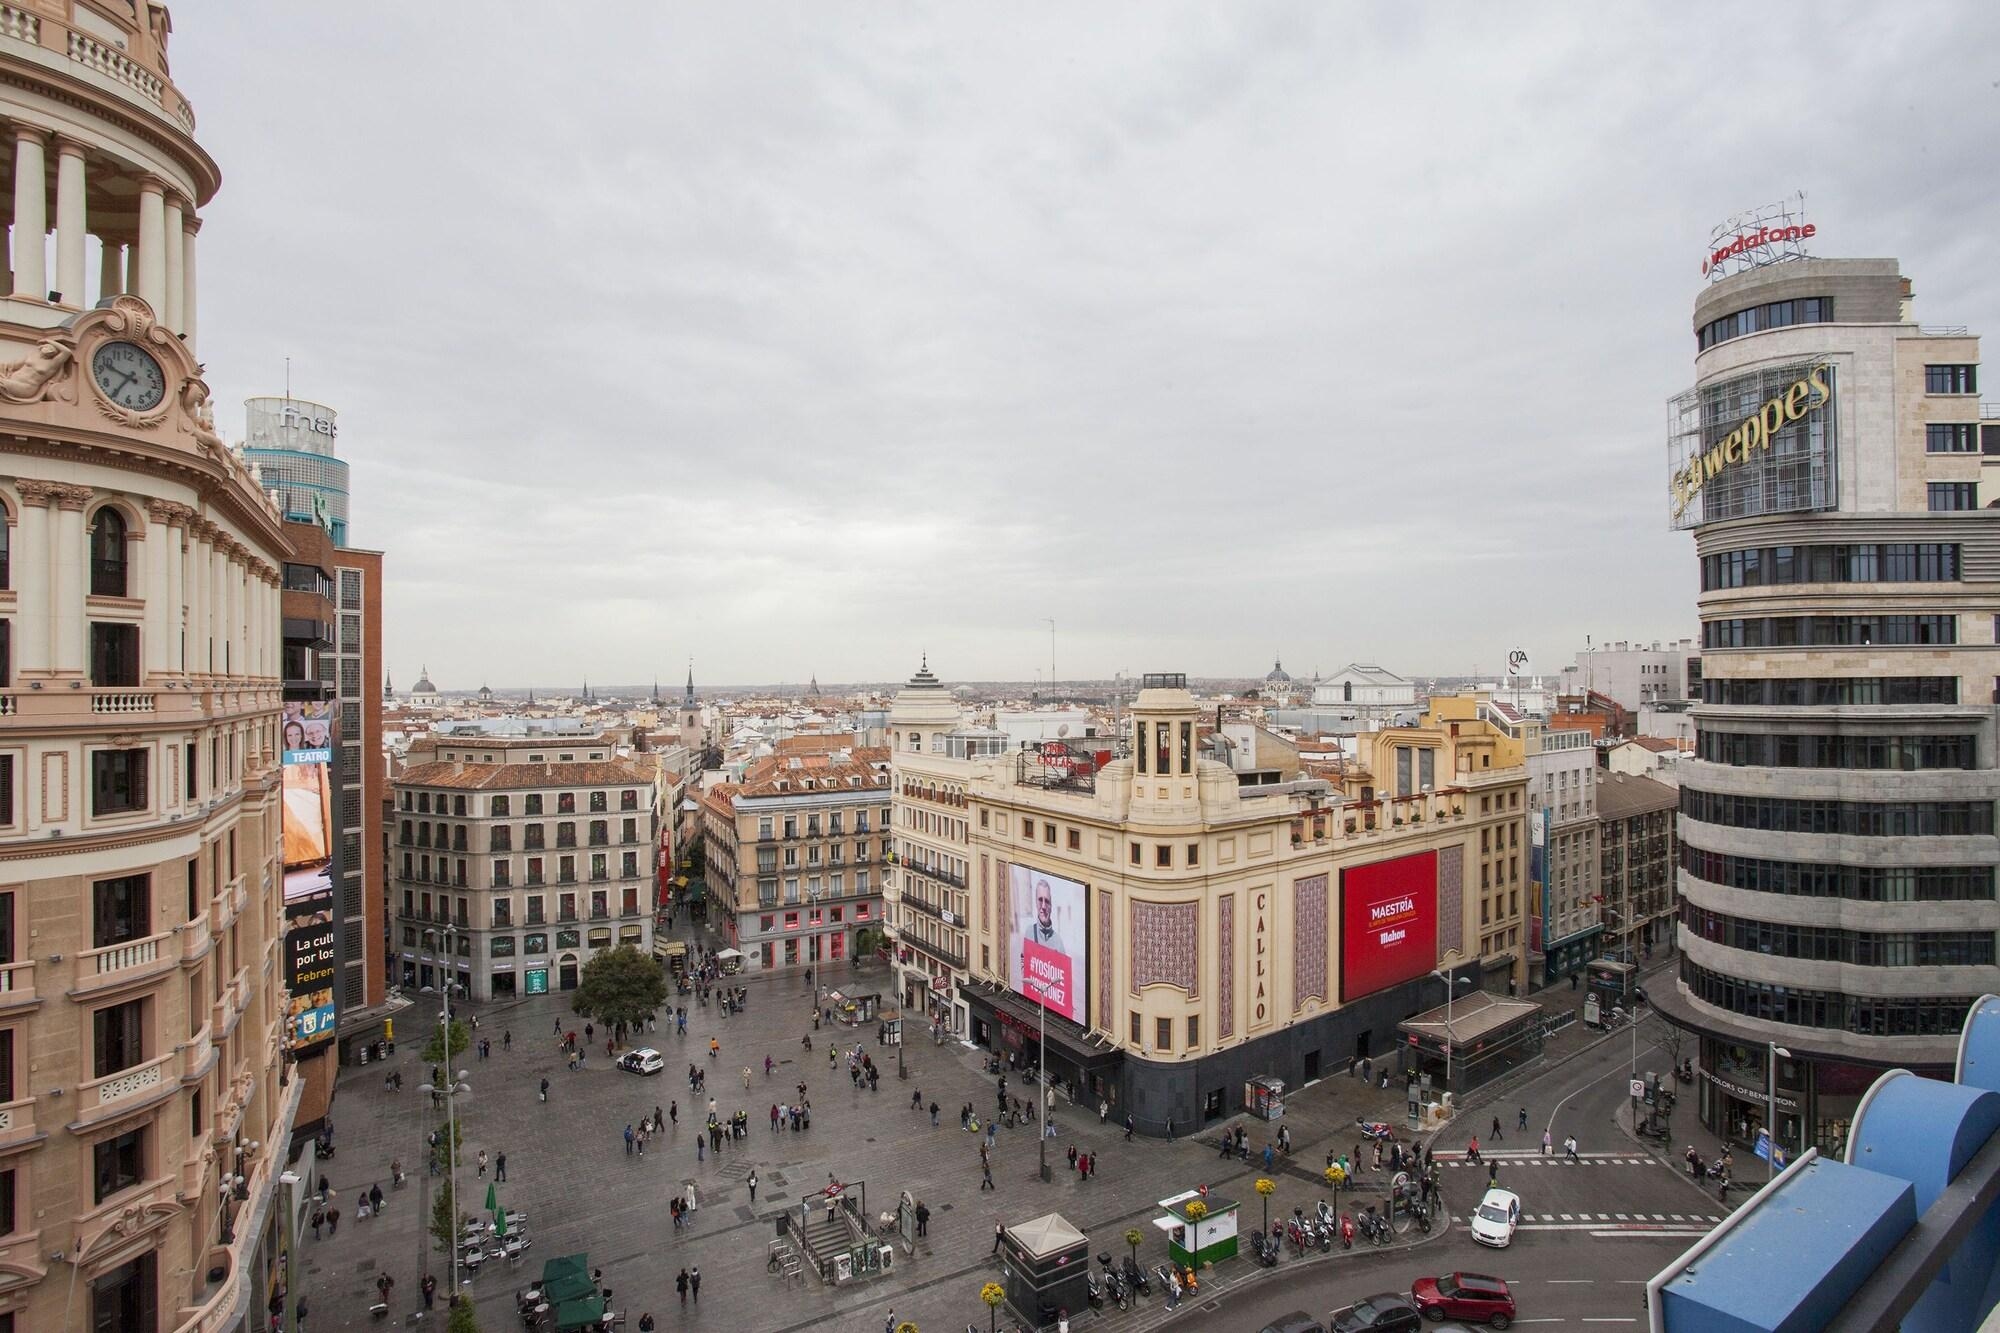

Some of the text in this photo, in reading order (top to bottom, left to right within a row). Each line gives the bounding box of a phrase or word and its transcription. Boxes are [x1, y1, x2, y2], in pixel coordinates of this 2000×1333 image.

[1711, 223, 1816, 265] vodafone
[123, 349, 134, 361] 12
[146, 369, 153, 379] 2
[151, 380, 157, 389] 3
[125, 395, 132, 404] 6
[138, 395, 145, 404] 5
[292, 751, 329, 762] TEATRO
[1371, 896, 1414, 920] MAESTRÍA
[1380, 929, 1406, 945] Mahou
[296, 939, 311, 951] La
[297, 948, 334, 968] por los
[1256, 894, 1265, 1019] CALLAO
[1710, 1075, 1735, 1091] COLORS
[1737, 1087, 1748, 1095] OF
